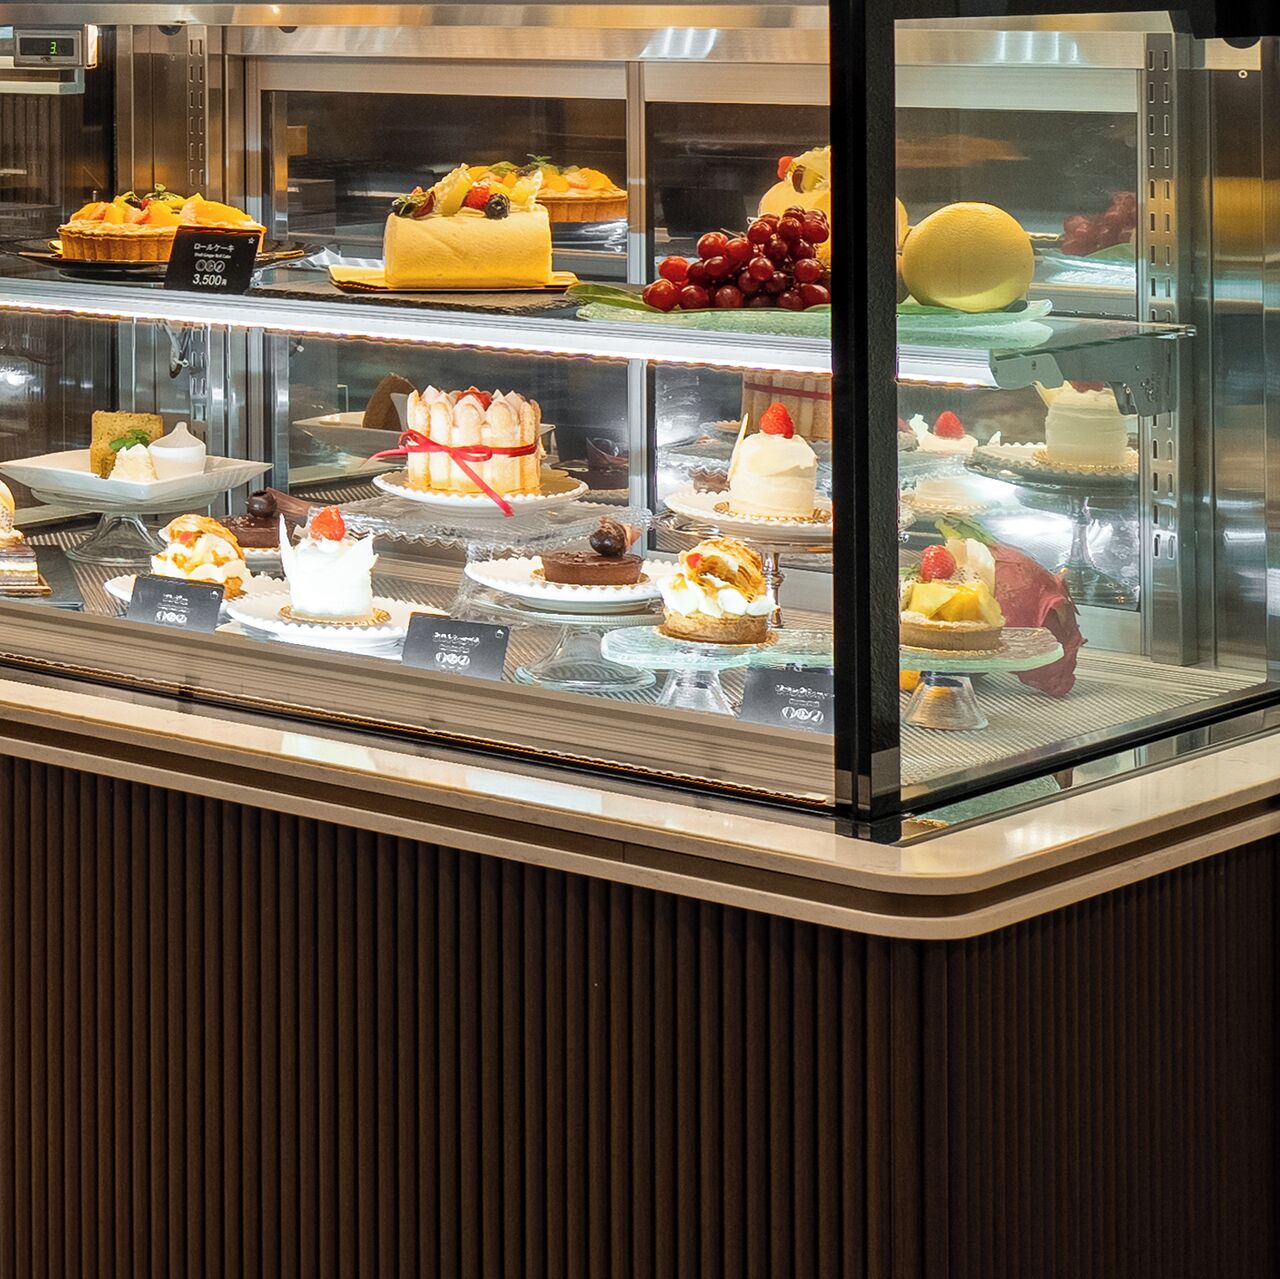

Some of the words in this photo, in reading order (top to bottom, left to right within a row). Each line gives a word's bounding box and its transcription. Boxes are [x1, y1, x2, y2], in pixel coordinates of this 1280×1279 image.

[193, 242, 235, 252] ロールケーキ
